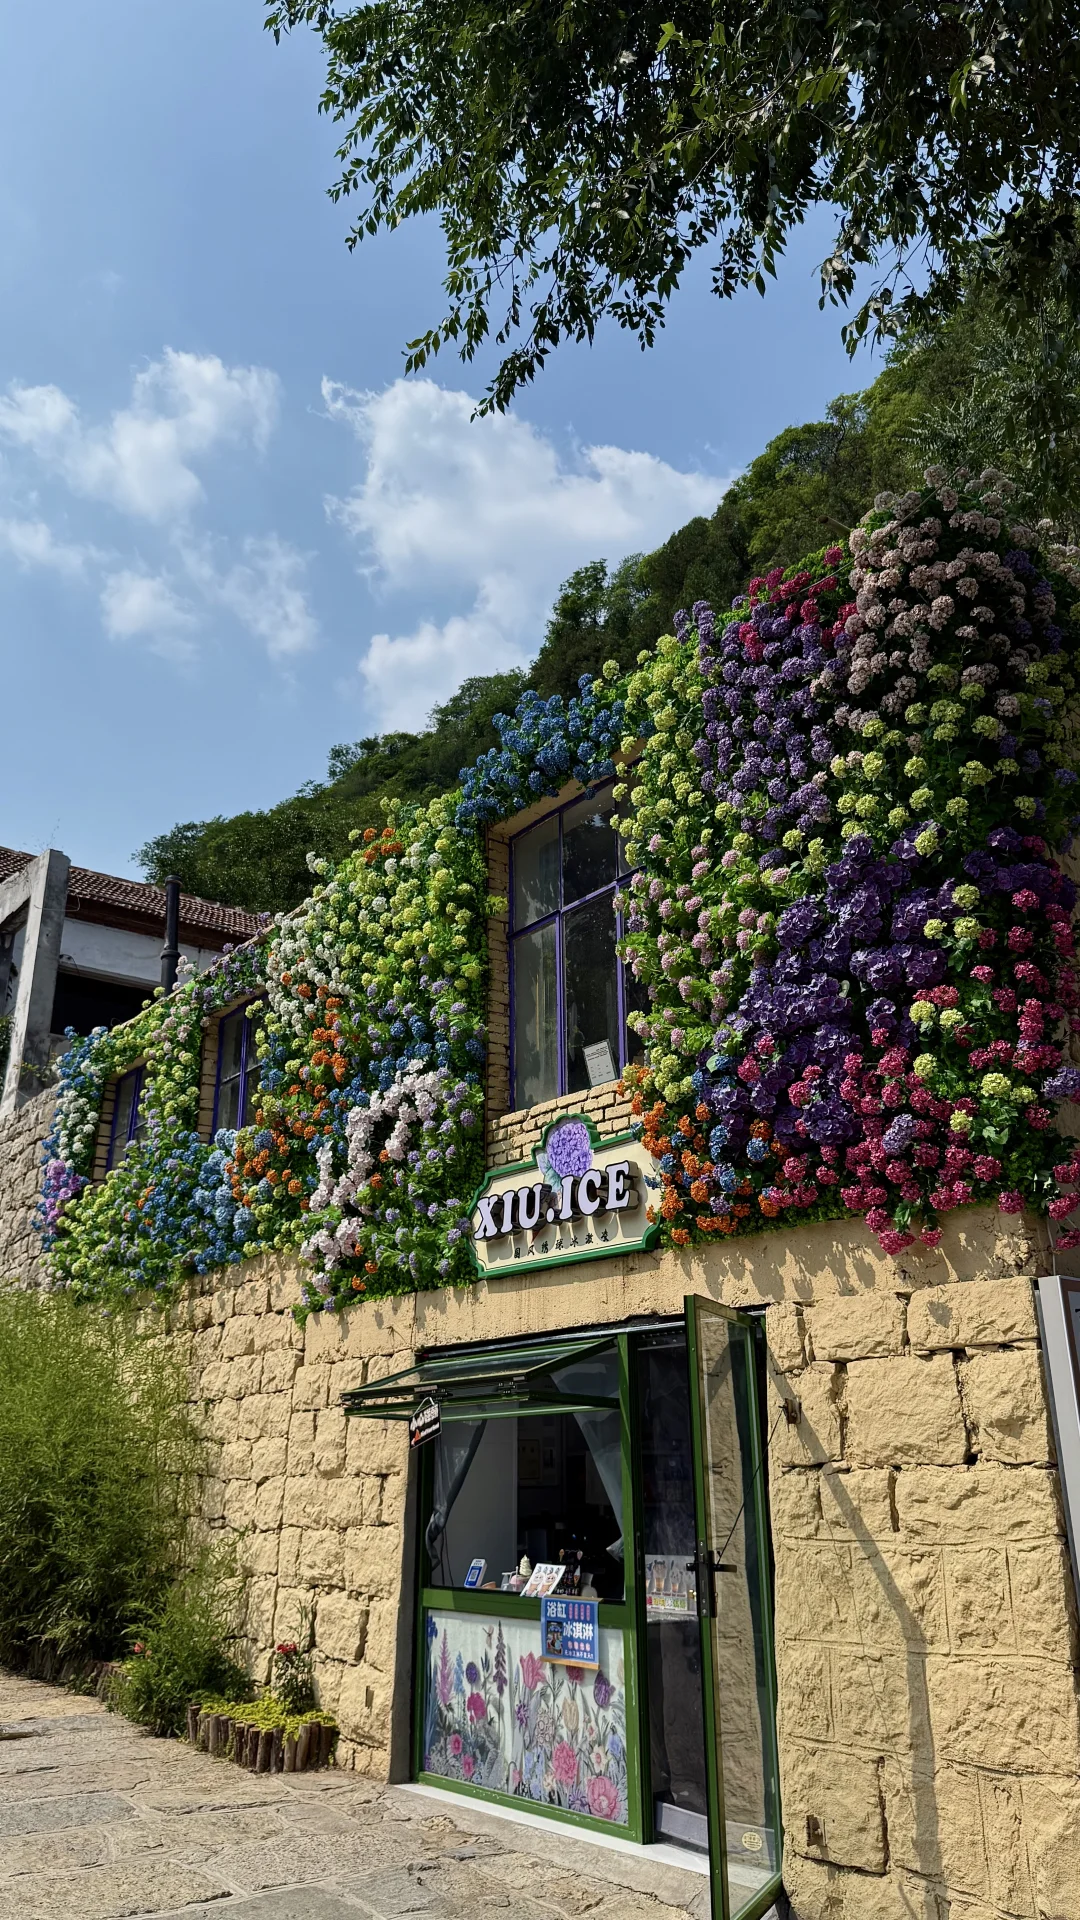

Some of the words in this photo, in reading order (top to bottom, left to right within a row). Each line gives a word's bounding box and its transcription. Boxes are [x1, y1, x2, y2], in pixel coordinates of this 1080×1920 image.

[473, 1160, 632, 1240] XIU.ICE
[563, 1621, 593, 1641] 冰淇淋
